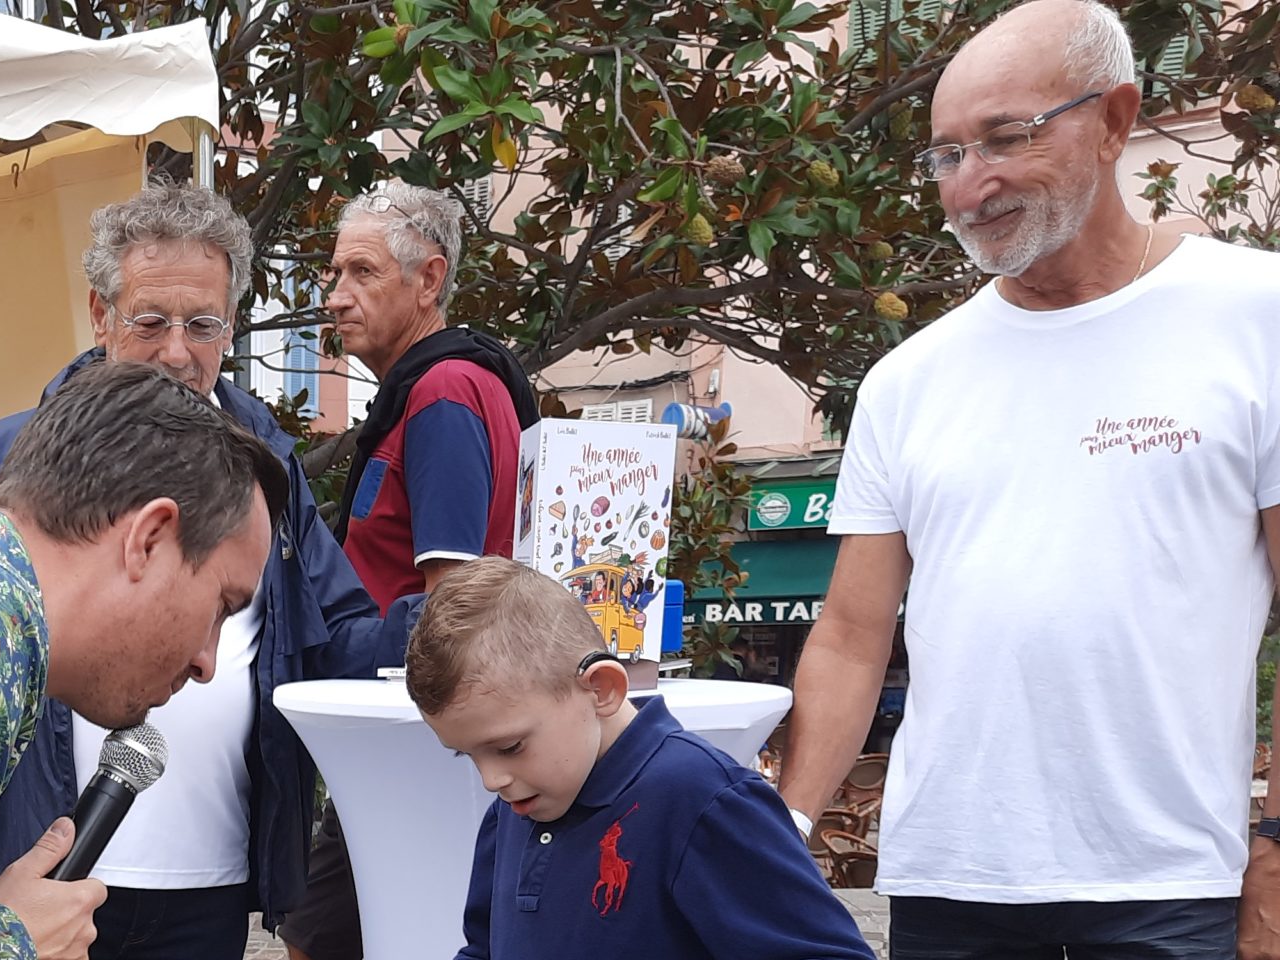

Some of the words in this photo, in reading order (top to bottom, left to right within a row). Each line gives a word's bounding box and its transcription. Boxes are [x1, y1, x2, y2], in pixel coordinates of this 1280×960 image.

[1096, 416, 1124, 435] Une
[1126, 415, 1178, 432] année
[1088, 432, 1136, 455] mieux
[1131, 427, 1202, 455] manger
[582, 442, 604, 467] Une
[606, 447, 643, 468] année
[578, 468, 613, 493] mieux
[610, 461, 658, 496] manger
[705, 602, 763, 622] BAR
